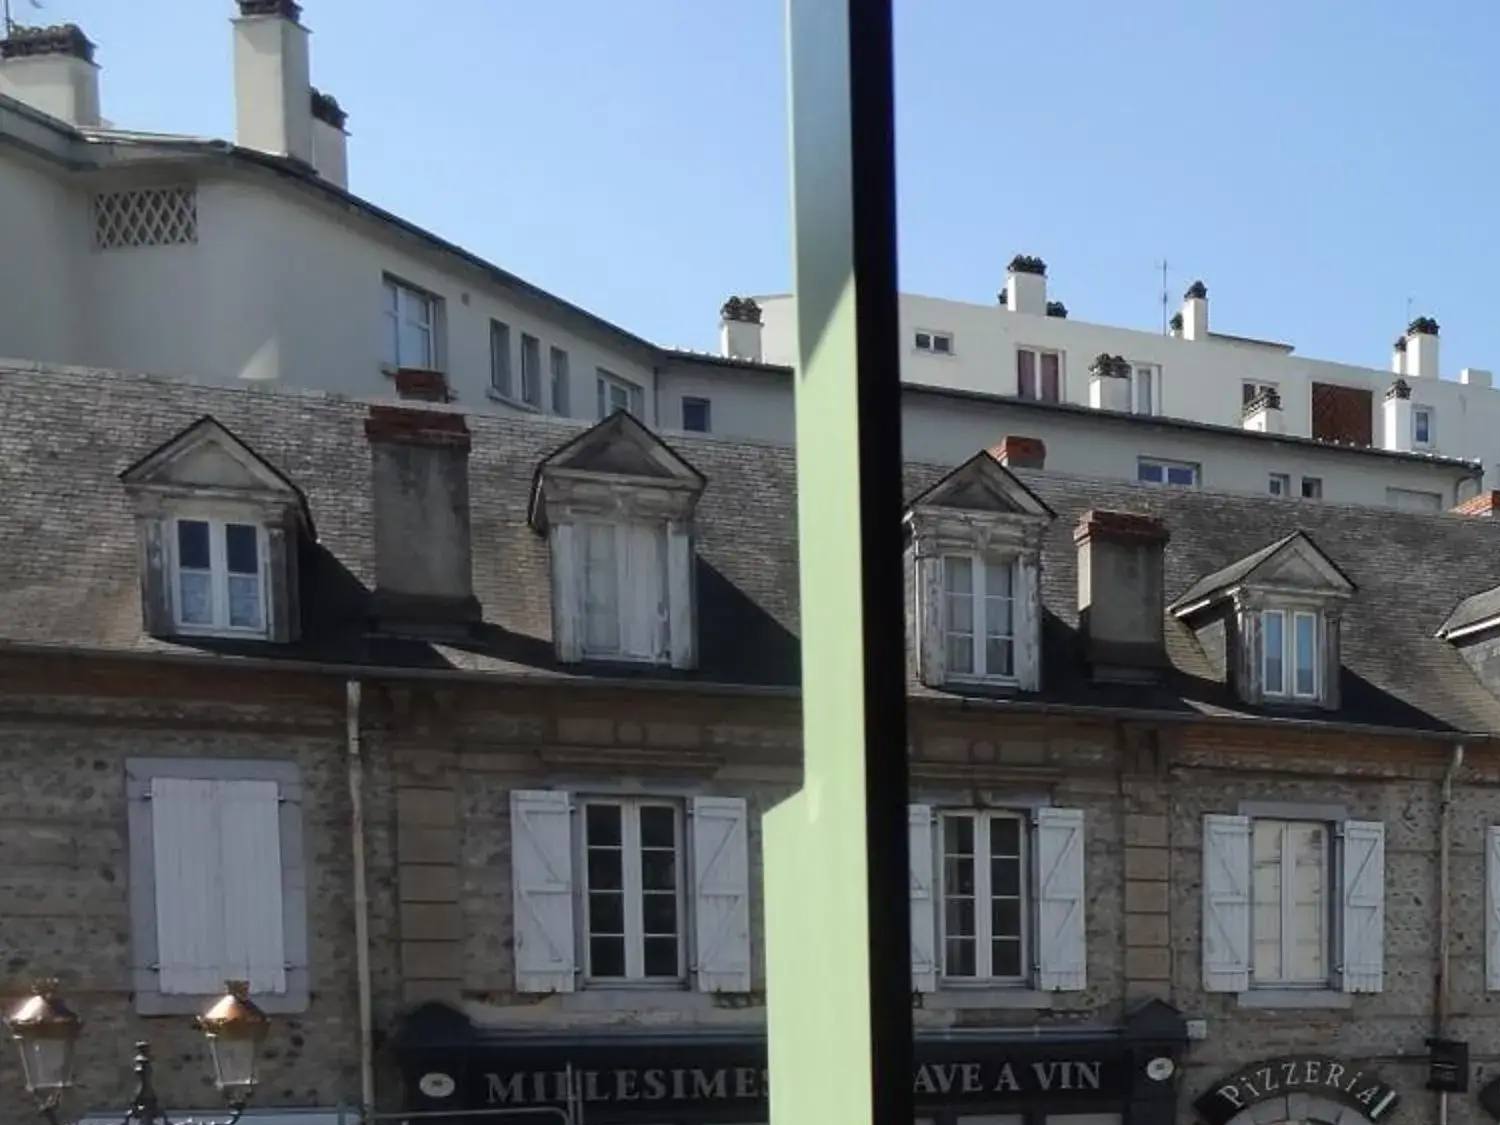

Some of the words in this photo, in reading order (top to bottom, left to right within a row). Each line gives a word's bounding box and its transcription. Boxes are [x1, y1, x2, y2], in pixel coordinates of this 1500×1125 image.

[914, 1062, 984, 1093] AVE
[993, 1061, 1023, 1092] A
[1031, 1060, 1102, 1091] VIN
